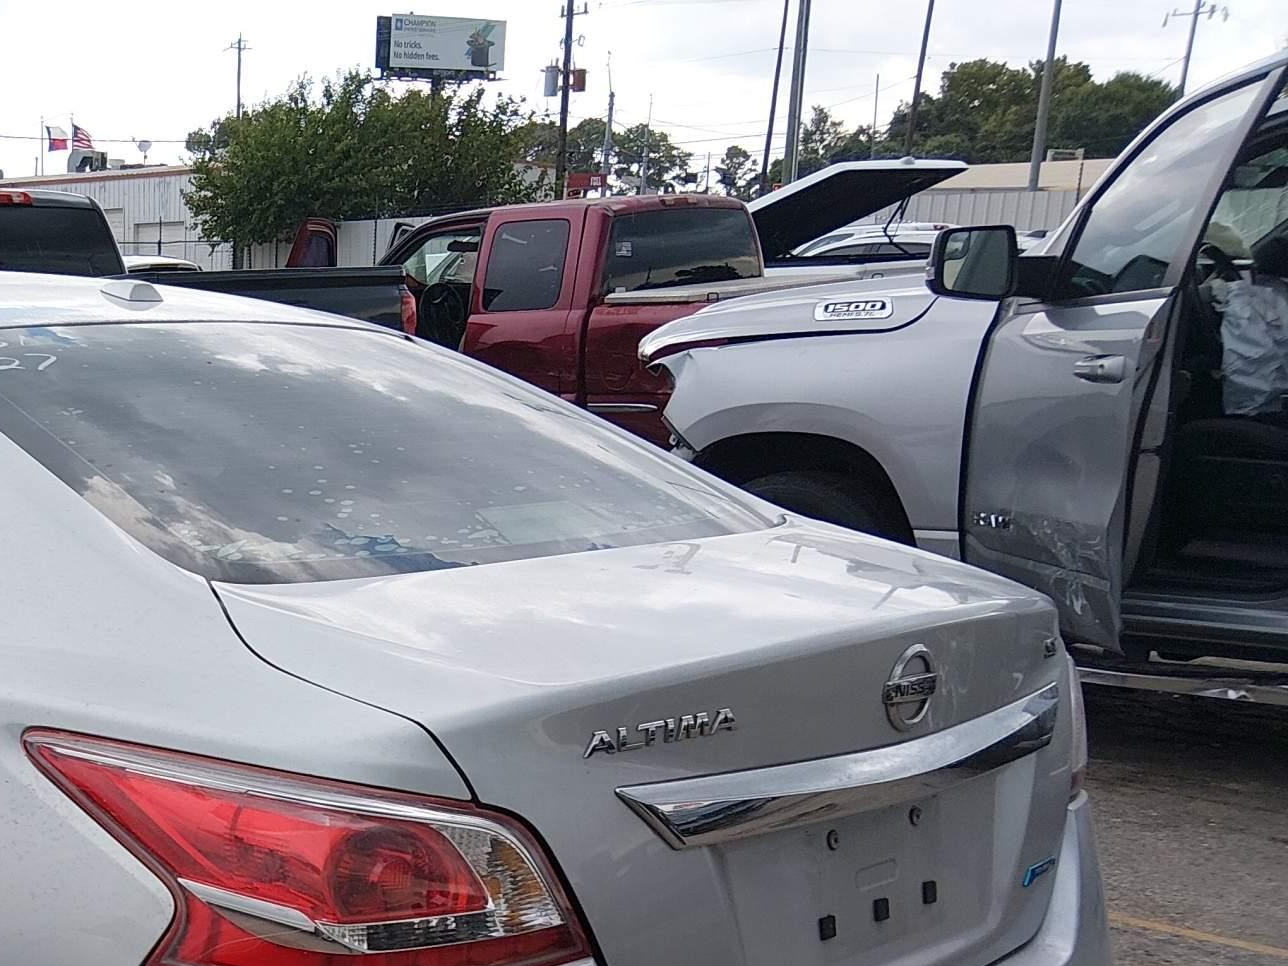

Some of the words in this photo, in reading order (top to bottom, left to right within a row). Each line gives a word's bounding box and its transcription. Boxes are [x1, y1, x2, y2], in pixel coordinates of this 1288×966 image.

[393, 40, 403, 49] No
[404, 40, 423, 50] tricks.
[393, 50, 403, 59] No
[404, 51, 424, 61] hidden
[426, 52, 441, 61] fees.
[827, 302, 882, 313] 1500
[583, 708, 737, 759] ALTIMA
